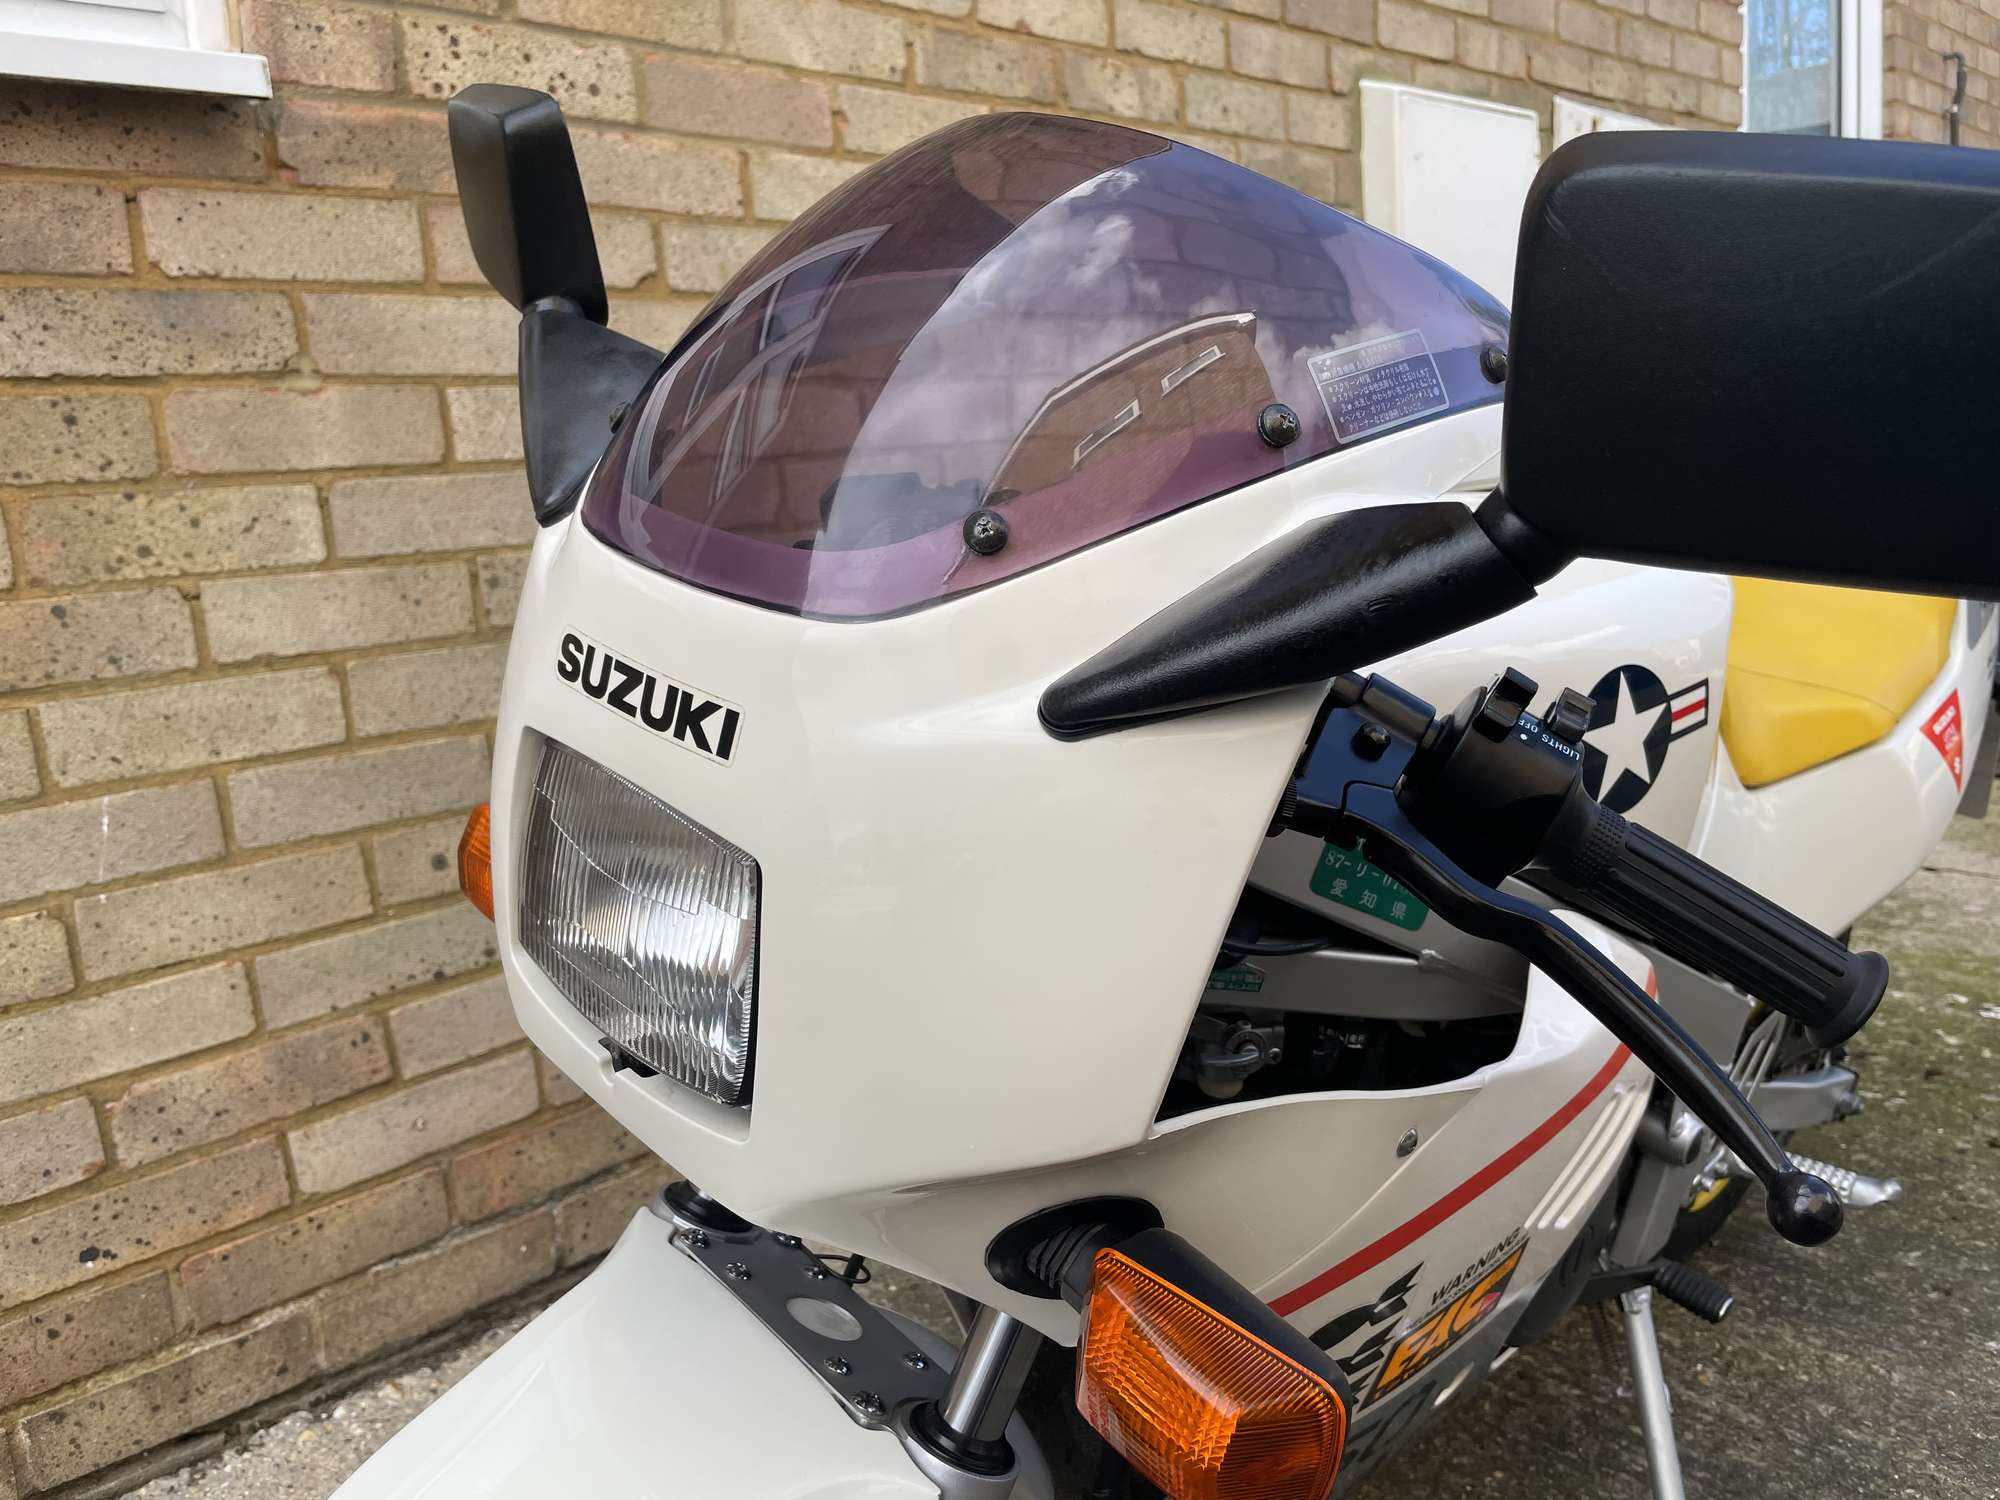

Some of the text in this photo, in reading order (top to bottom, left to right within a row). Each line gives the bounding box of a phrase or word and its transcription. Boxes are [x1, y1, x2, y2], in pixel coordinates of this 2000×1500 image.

[557, 633, 740, 761] SUZUKI
[1518, 719, 1580, 761] LIGHTS OFF
[1329, 878, 1408, 920] 愛知県
[1431, 1226, 1521, 1306] WARNING
